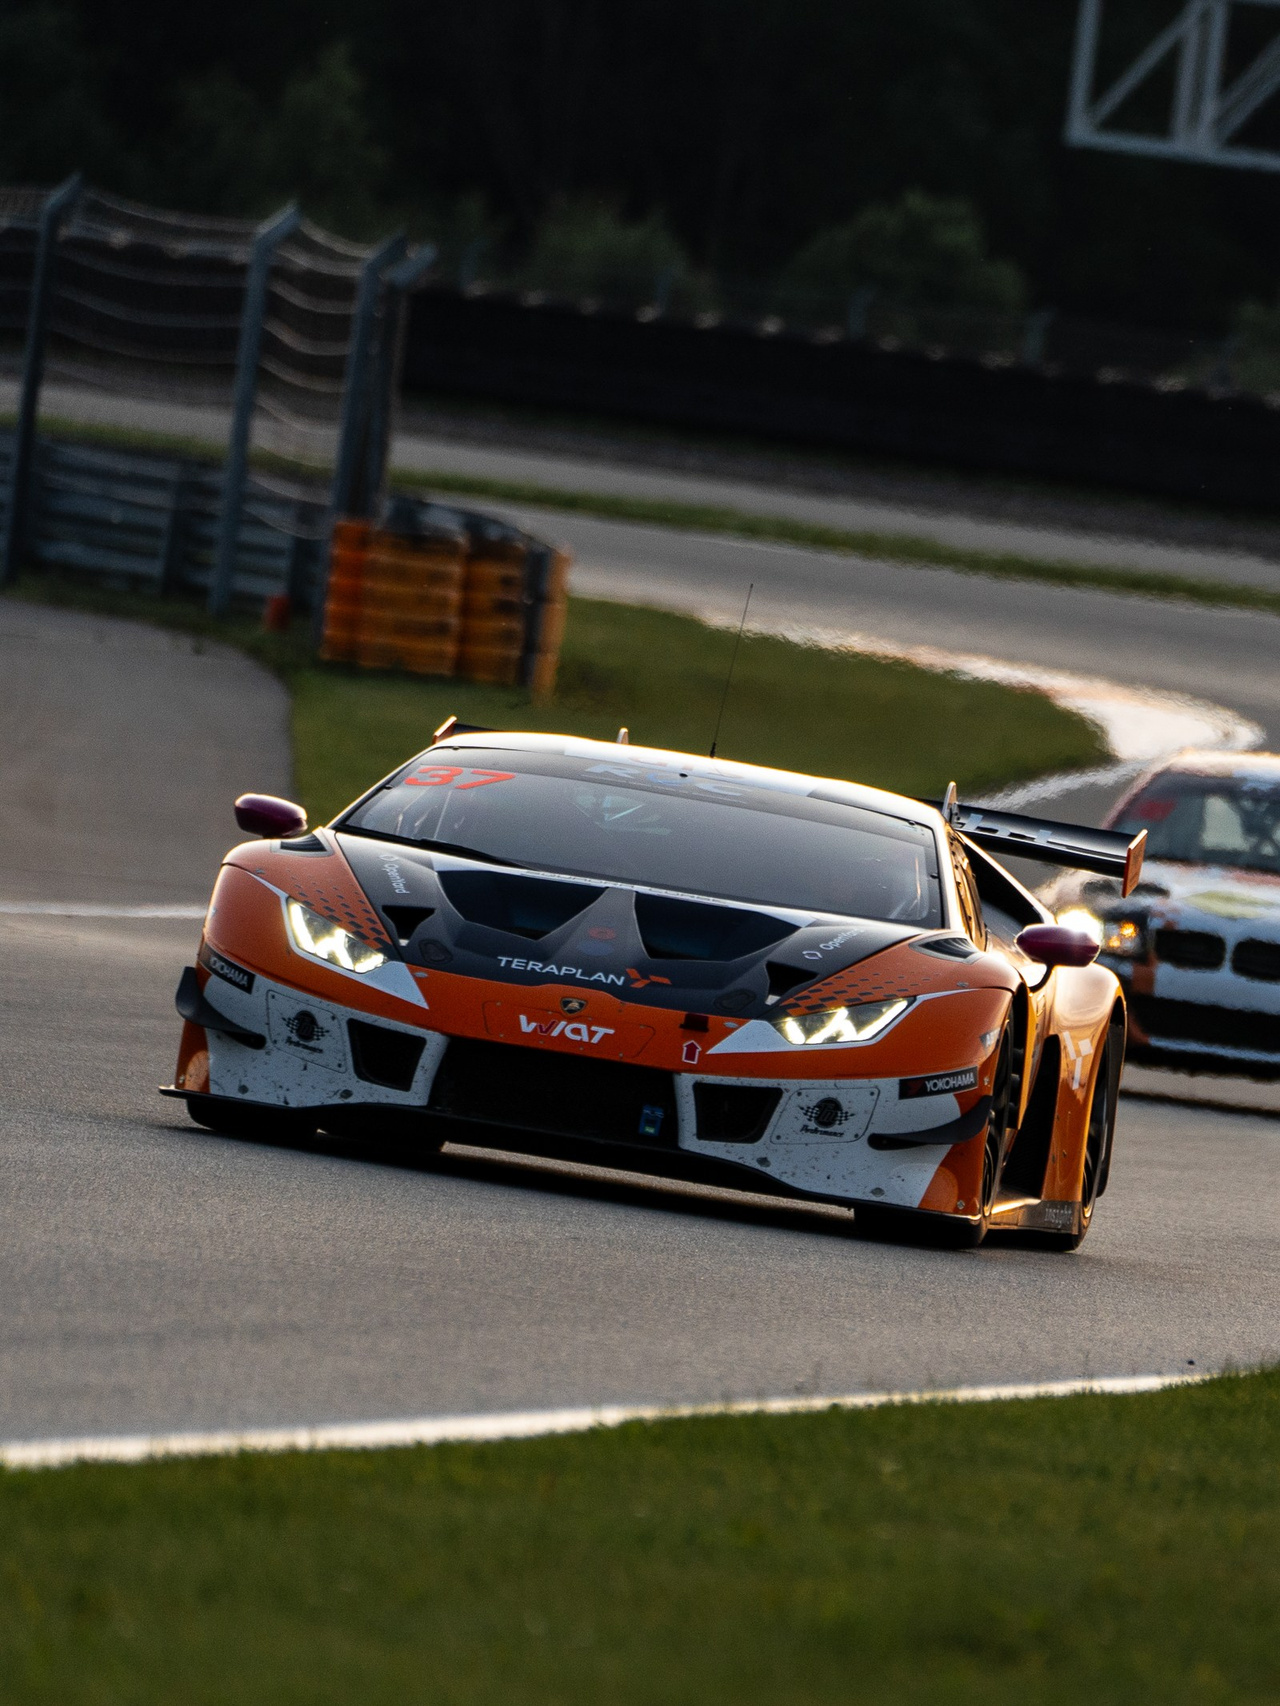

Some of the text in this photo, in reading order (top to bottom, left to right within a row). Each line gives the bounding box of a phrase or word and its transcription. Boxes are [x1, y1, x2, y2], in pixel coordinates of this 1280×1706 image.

[404, 766, 516, 789] 37
[497, 956, 625, 986] TERAPLAN
[925, 1072, 975, 1092] YOKOHAMA
